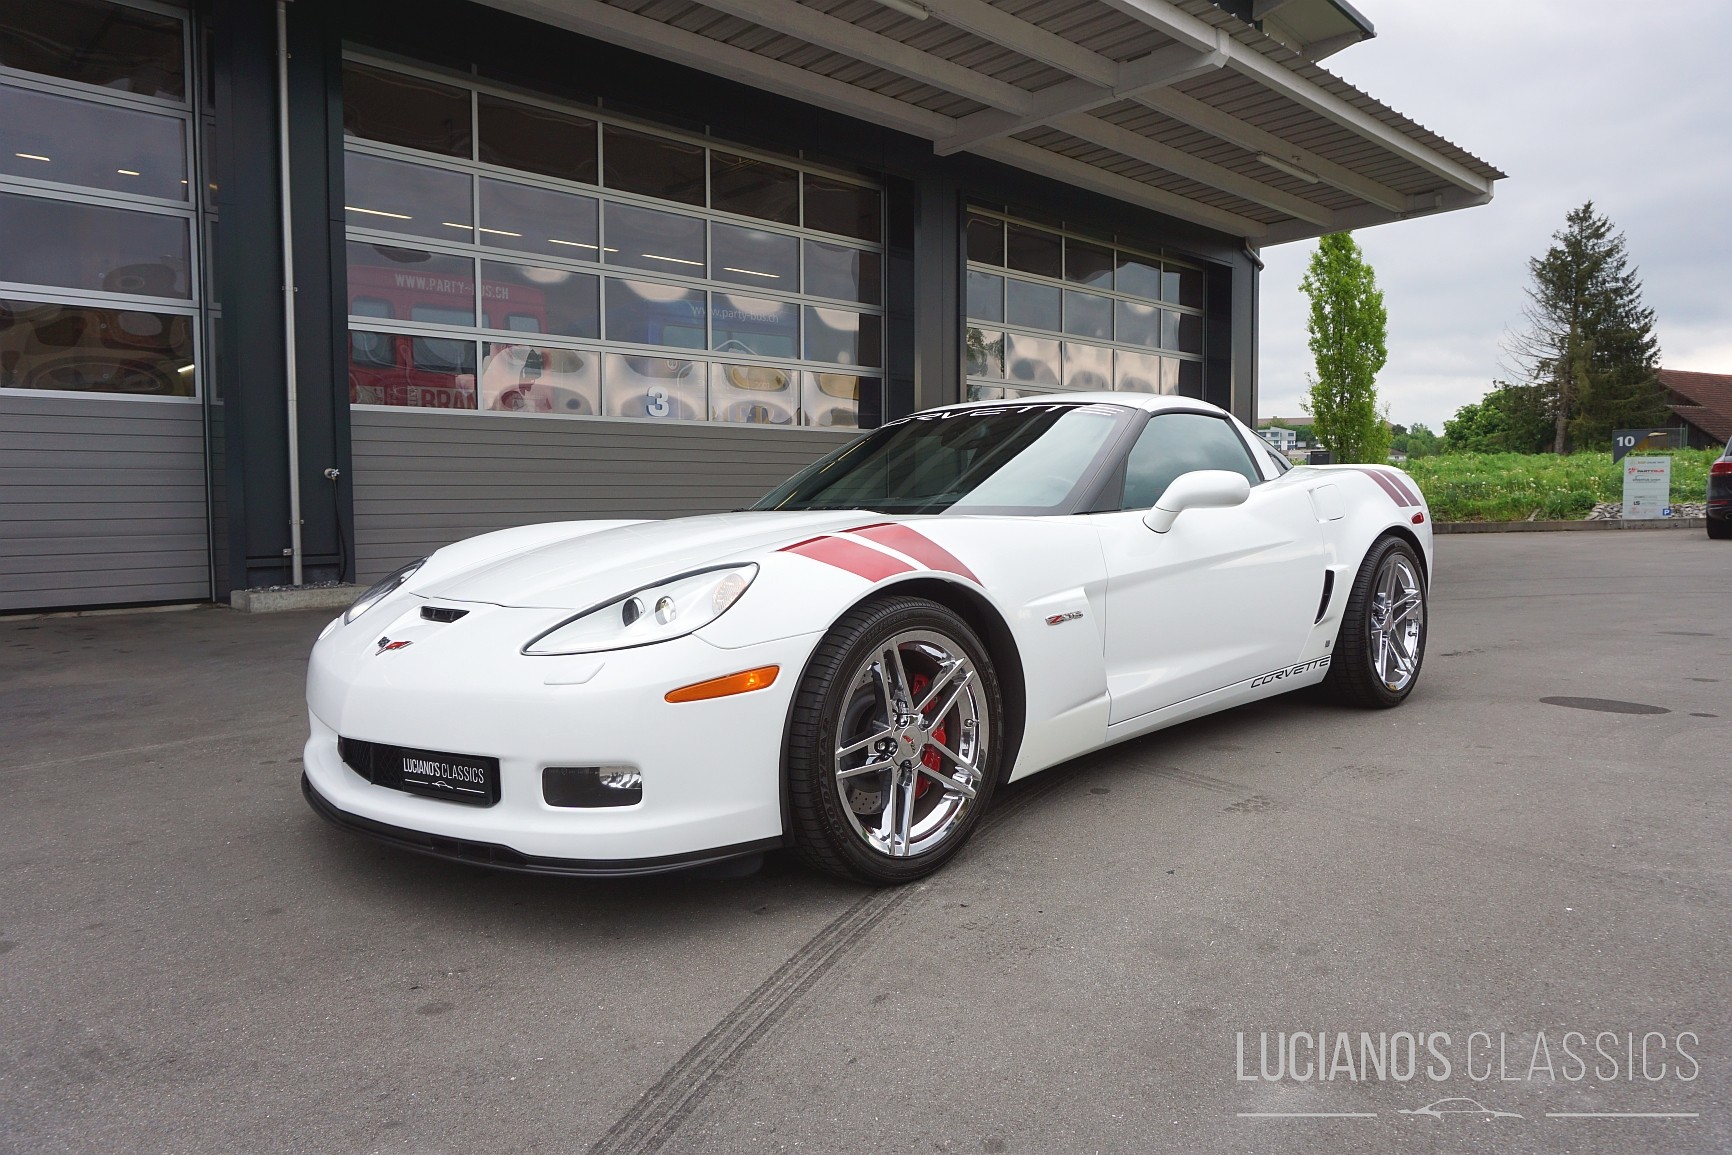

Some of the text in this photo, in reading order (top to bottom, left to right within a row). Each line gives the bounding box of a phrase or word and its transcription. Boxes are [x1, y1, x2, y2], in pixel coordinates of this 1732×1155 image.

[647, 386, 669, 417] 3
[1617, 436, 1635, 447] 10
[1250, 655, 1331, 689] CORVETTE
[403, 757, 485, 784] LUCIANO'S CLASSICS
